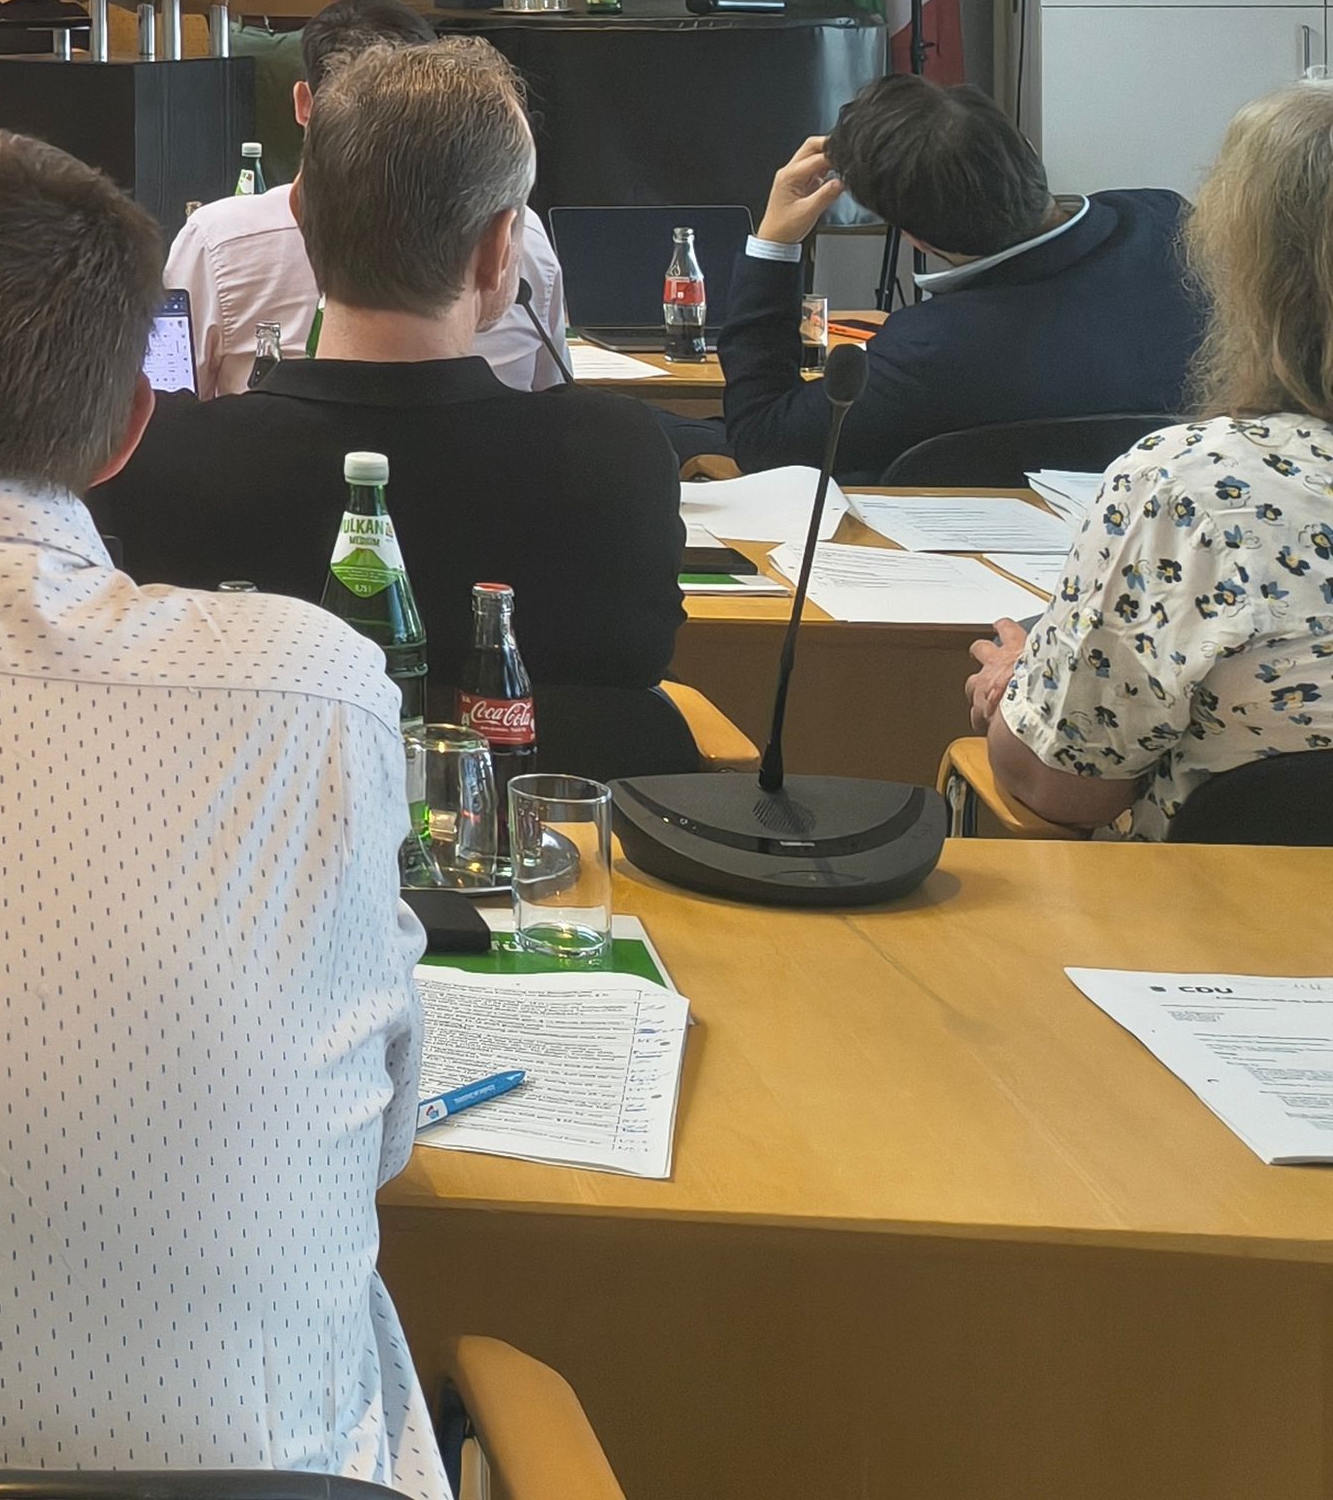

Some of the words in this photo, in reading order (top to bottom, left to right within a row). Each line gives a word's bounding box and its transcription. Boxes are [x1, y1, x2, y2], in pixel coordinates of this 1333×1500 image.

[343, 518, 384, 535] ULKAN
[471, 701, 532, 727] Coca-Cola
[1178, 986, 1233, 994] CDU
